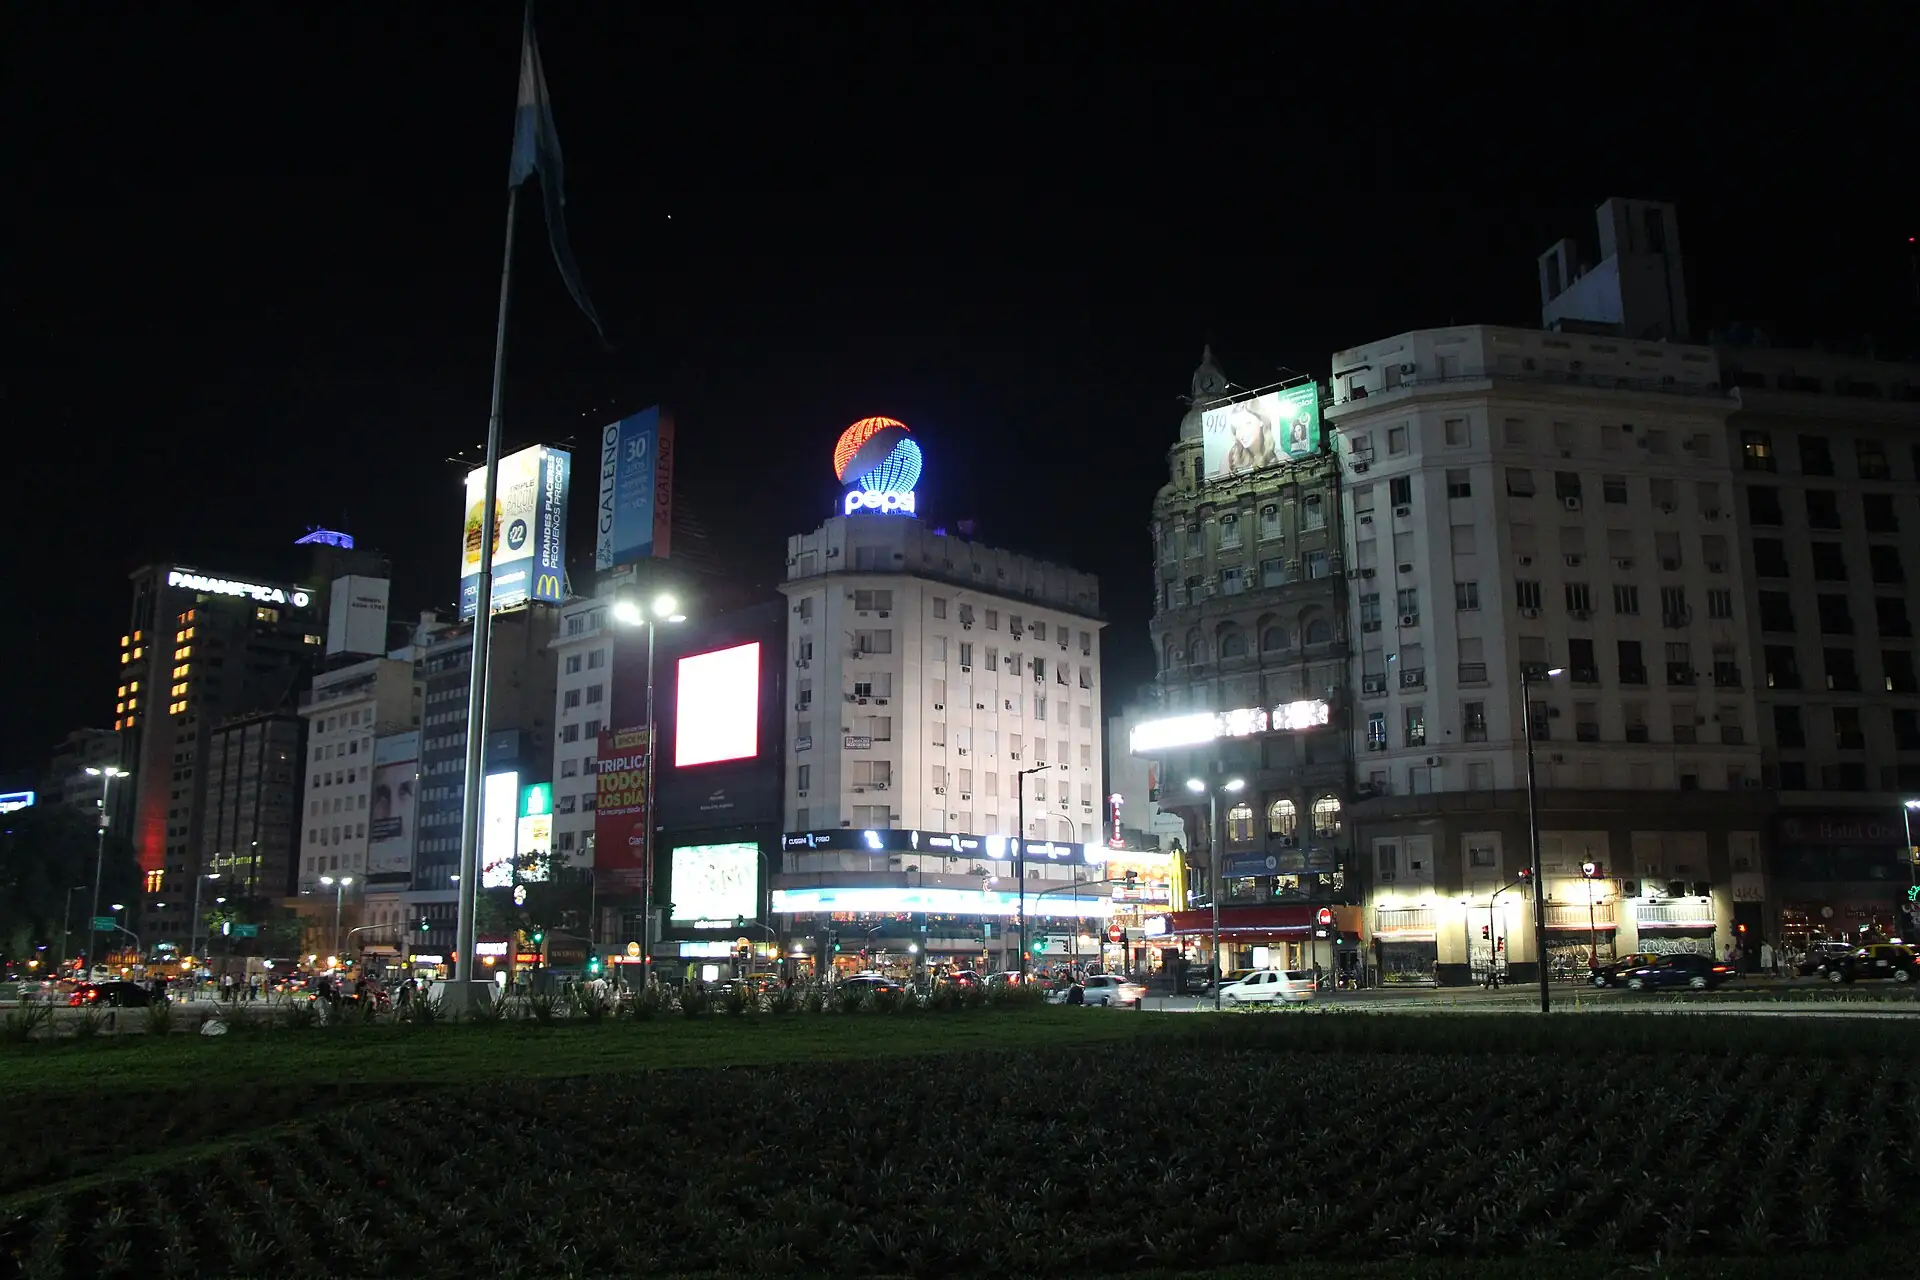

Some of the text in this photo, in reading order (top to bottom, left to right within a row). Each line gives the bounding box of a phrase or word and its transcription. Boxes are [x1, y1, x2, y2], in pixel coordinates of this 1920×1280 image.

[626, 437, 646, 462] 30
[510, 478, 536, 493] TRIPLE
[600, 426, 618, 534] GALENO
[656, 437, 671, 506] GALENO
[542, 454, 555, 568] GRANDES PLACERES
[550, 456, 564, 569] PEQUEÑOS PRECIOS
[845, 489, 915, 515] pepsi
[168, 571, 309, 607] PANAMERICANO
[598, 787, 645, 809] LOS DÍA
